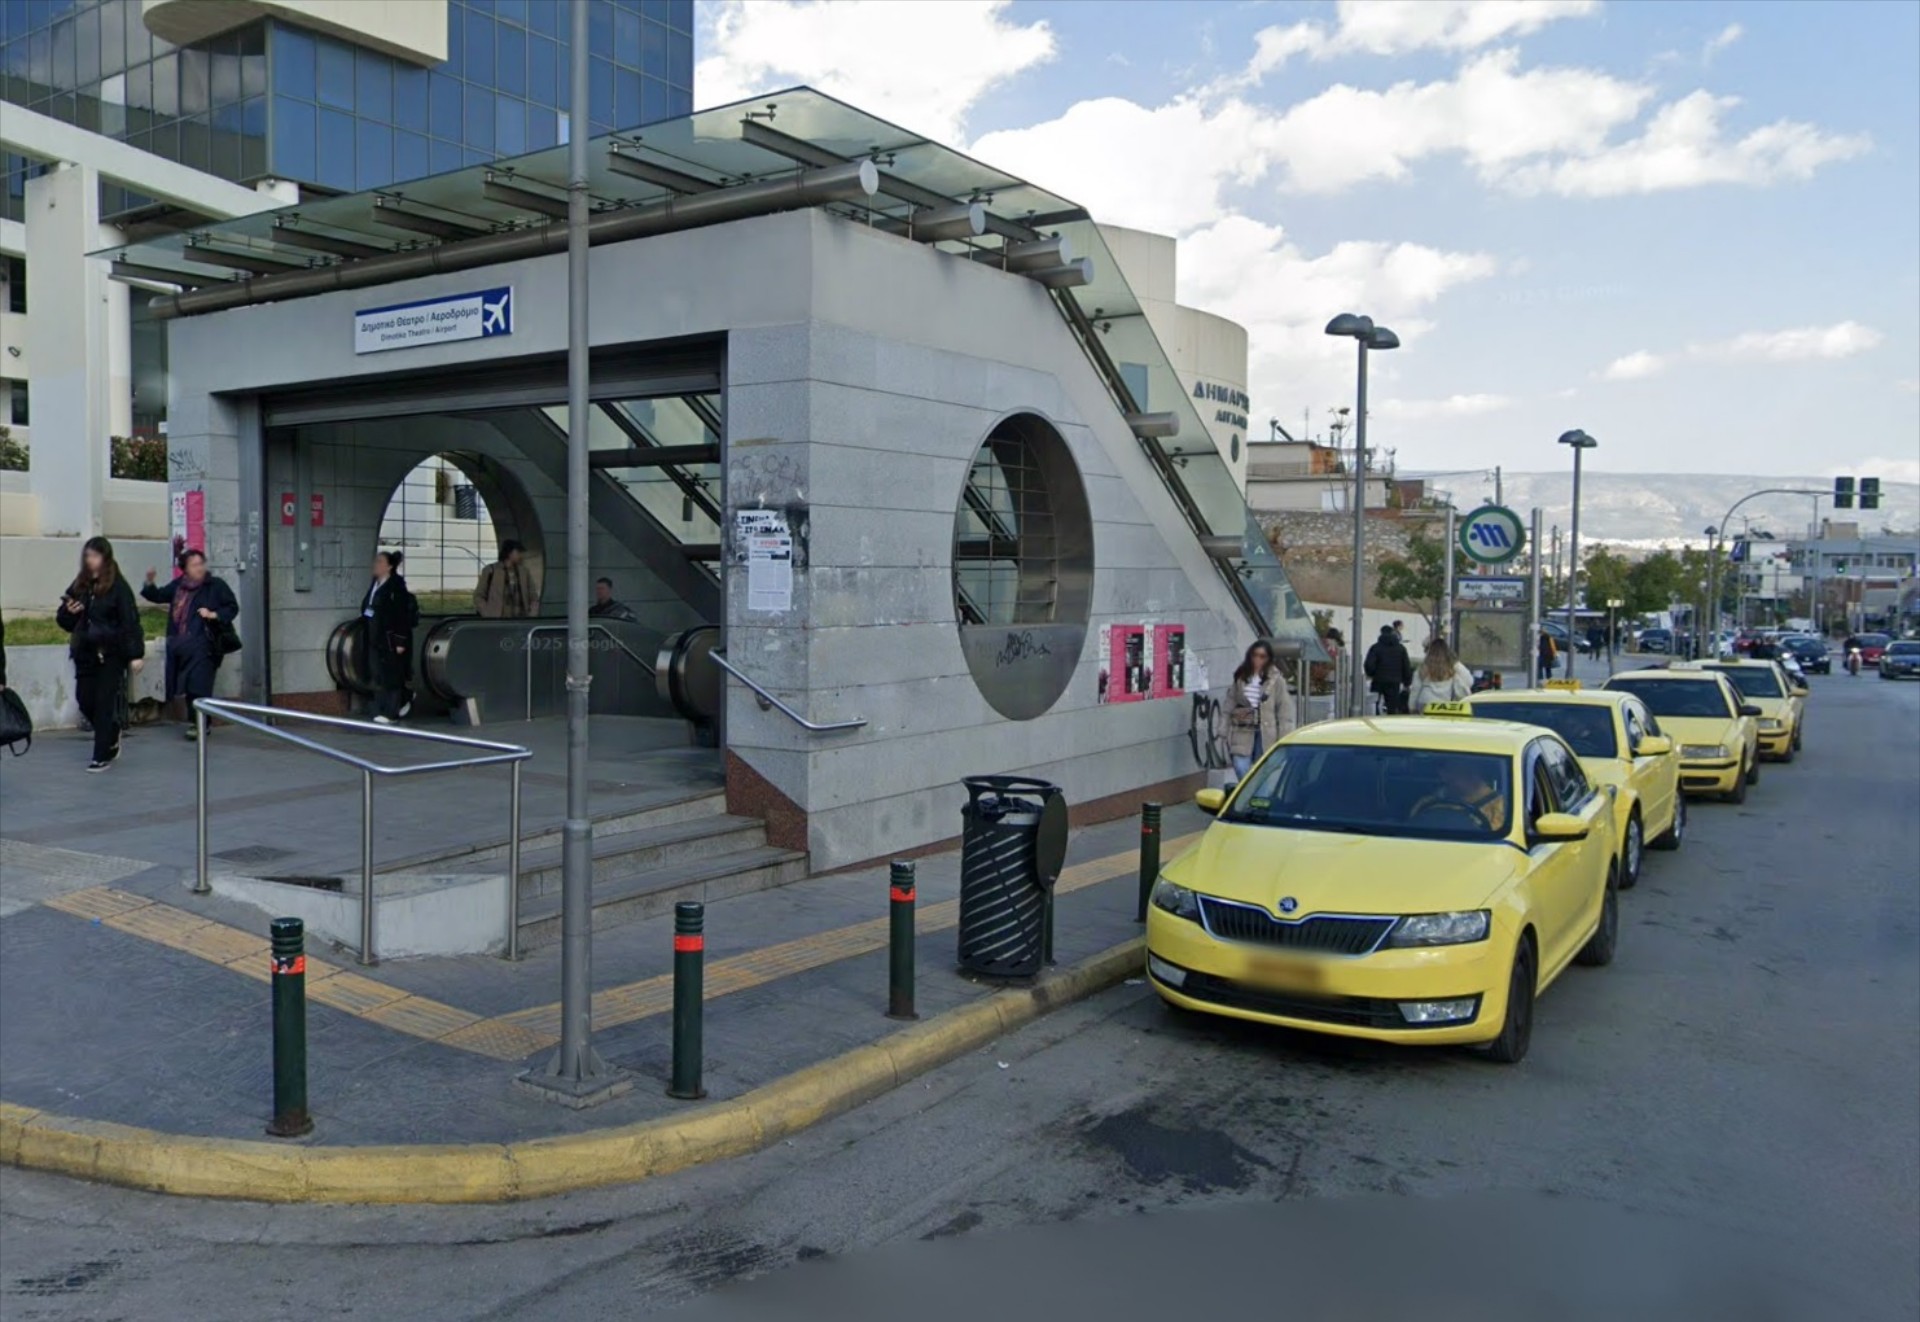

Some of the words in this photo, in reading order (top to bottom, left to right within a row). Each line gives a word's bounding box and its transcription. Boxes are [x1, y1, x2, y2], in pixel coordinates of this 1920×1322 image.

[396, 315, 426, 329] Θέατρο
[430, 307, 479, 321] Αεροδρόμιο
[435, 324, 457, 334] Airport
[1430, 702, 1464, 711] ΤΑΞΙ
